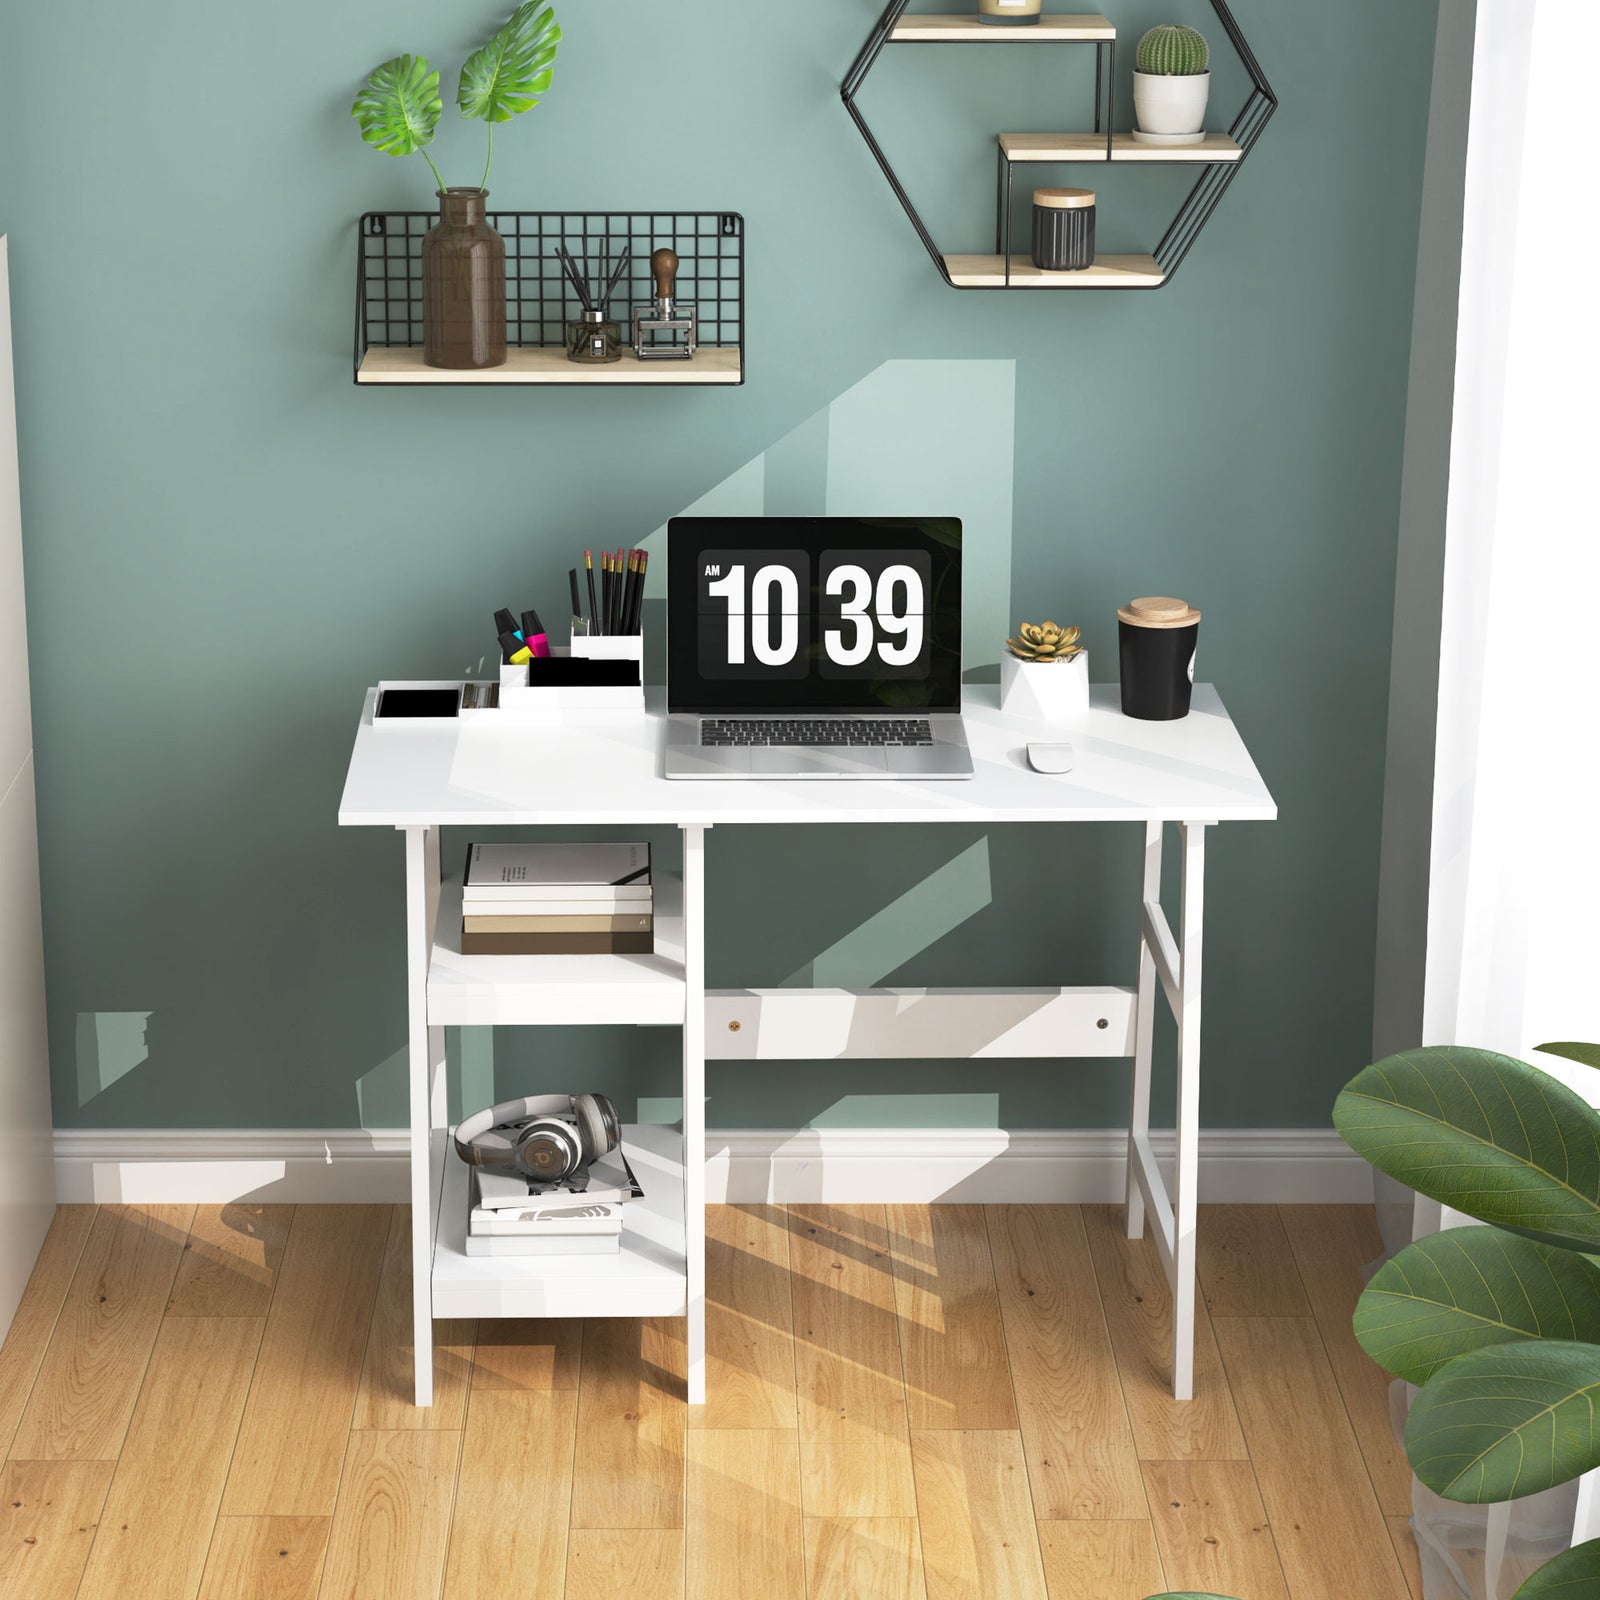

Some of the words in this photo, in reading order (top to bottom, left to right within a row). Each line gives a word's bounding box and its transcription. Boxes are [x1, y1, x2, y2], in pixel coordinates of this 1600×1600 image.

[705, 565, 720, 576] AM
[709, 565, 798, 666] 10
[825, 565, 924, 666] 39
